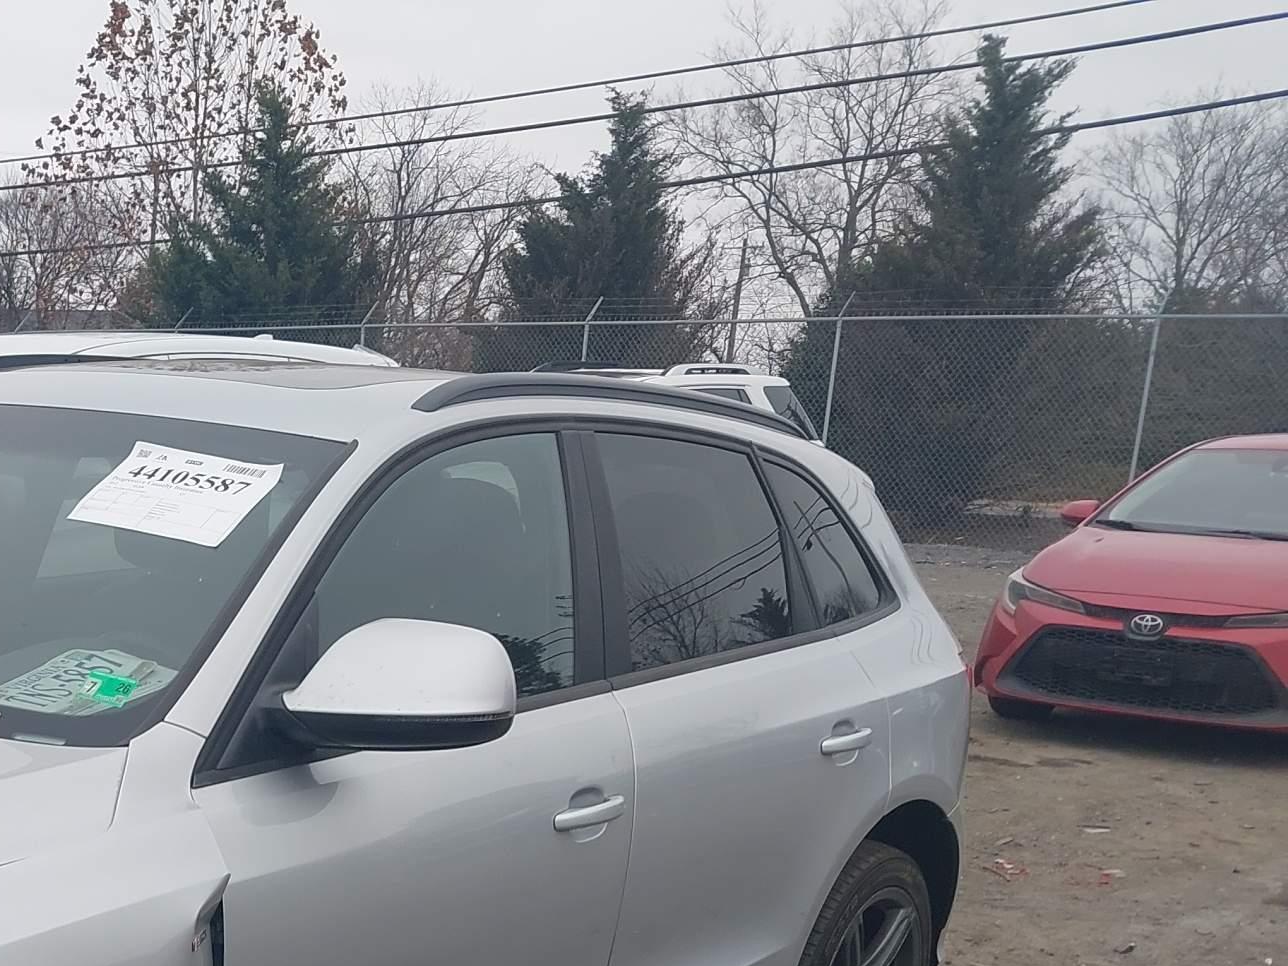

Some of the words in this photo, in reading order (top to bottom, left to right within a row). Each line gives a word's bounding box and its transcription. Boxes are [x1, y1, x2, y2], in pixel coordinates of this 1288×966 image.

[128, 465, 253, 495] 44105587
[86, 681, 98, 693] 7
[115, 682, 132, 695] 26
